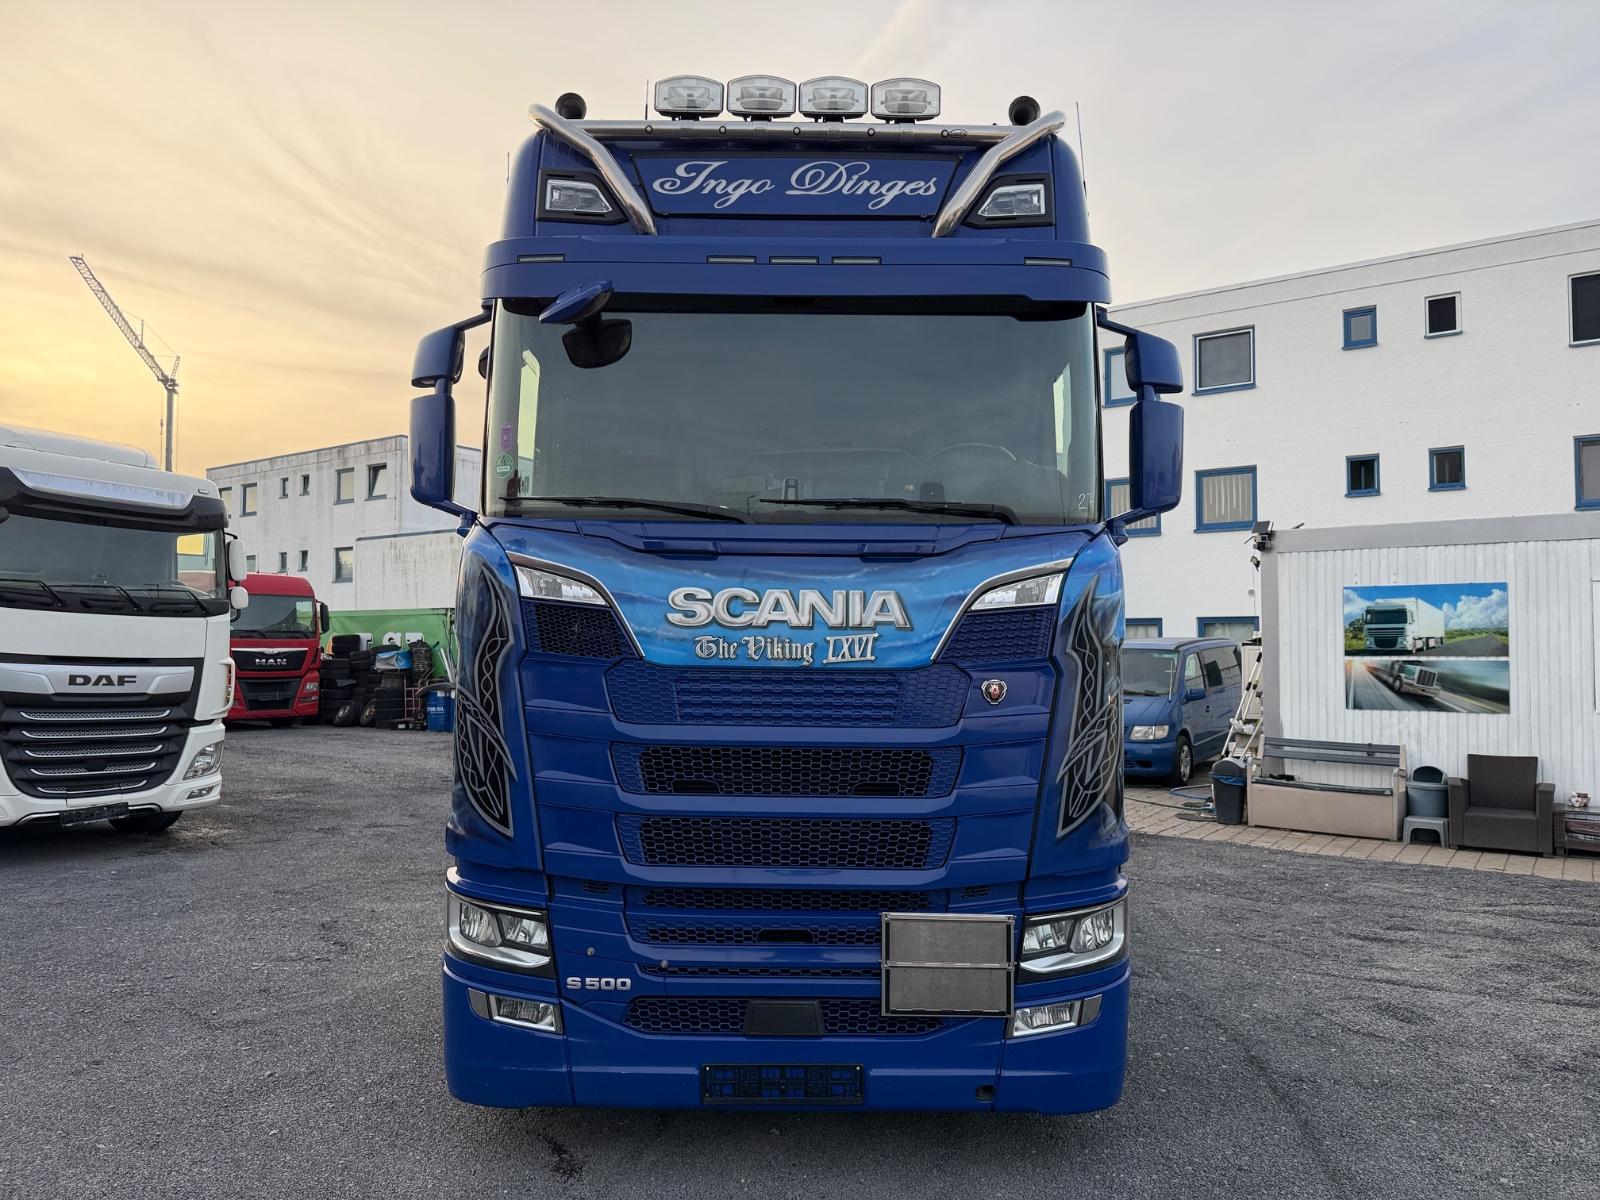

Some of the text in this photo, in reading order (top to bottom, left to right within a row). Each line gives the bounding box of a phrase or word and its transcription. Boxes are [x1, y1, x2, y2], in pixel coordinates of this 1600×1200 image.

[652, 160, 938, 210] Ingo Dinges
[666, 586, 911, 629] SCANIA
[694, 632, 880, 666] The Viking LXVI
[255, 658, 287, 666] MAN
[68, 674, 137, 687] DAF
[566, 976, 632, 991] S 500
